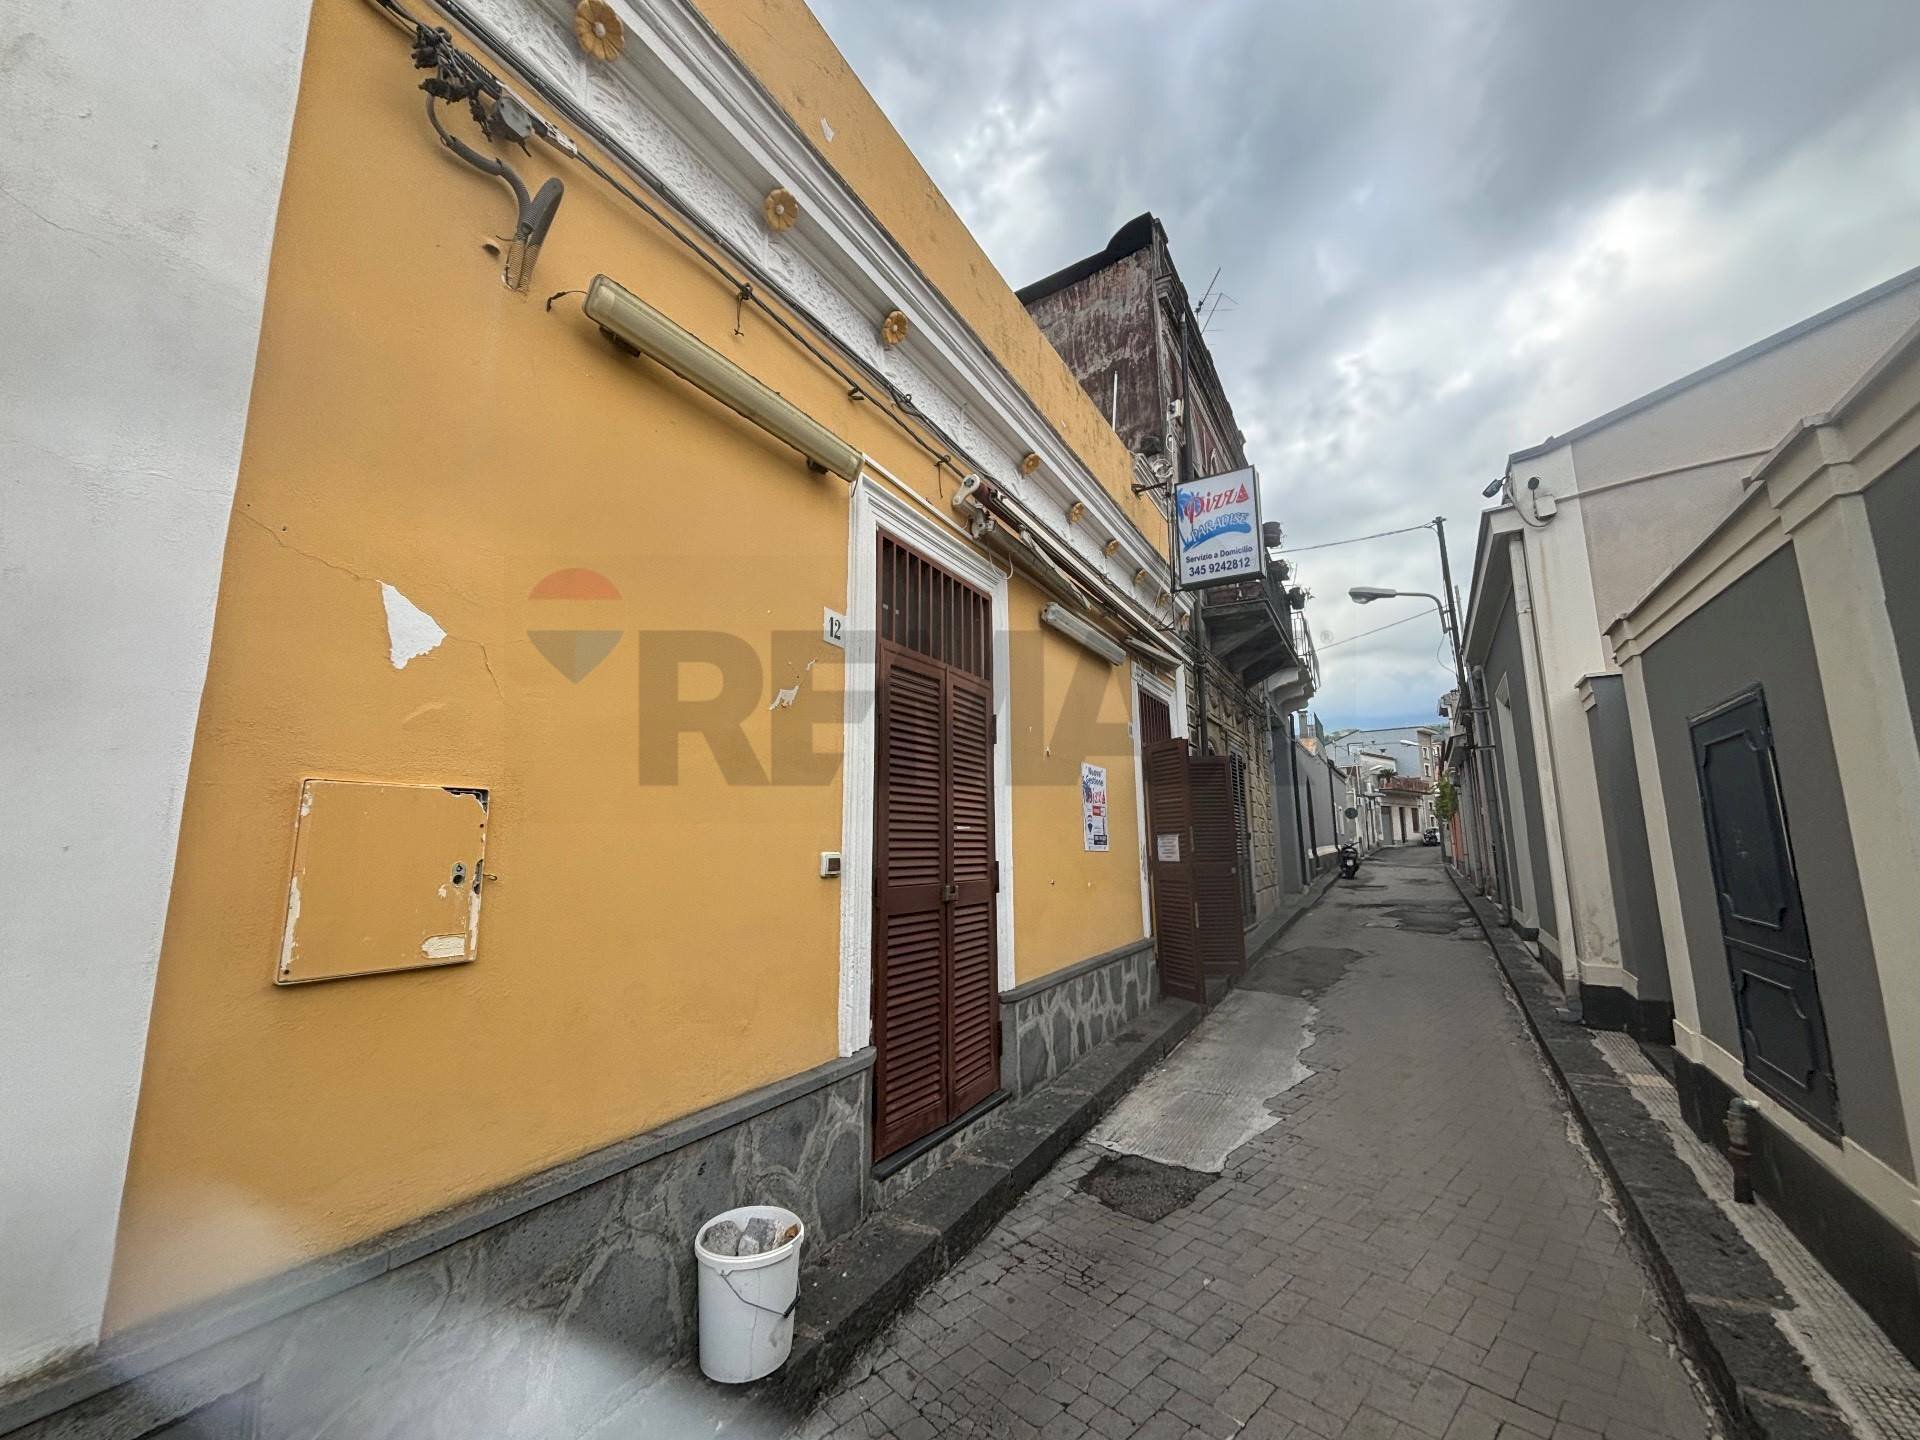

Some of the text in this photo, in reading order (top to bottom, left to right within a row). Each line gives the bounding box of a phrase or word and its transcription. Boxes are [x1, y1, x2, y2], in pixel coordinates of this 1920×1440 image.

[1185, 552, 1213, 563] Servizio
[1220, 544, 1253, 557] Domicilio
[1189, 557, 1251, 577] 345 9242812
[828, 616, 841, 641] 12
